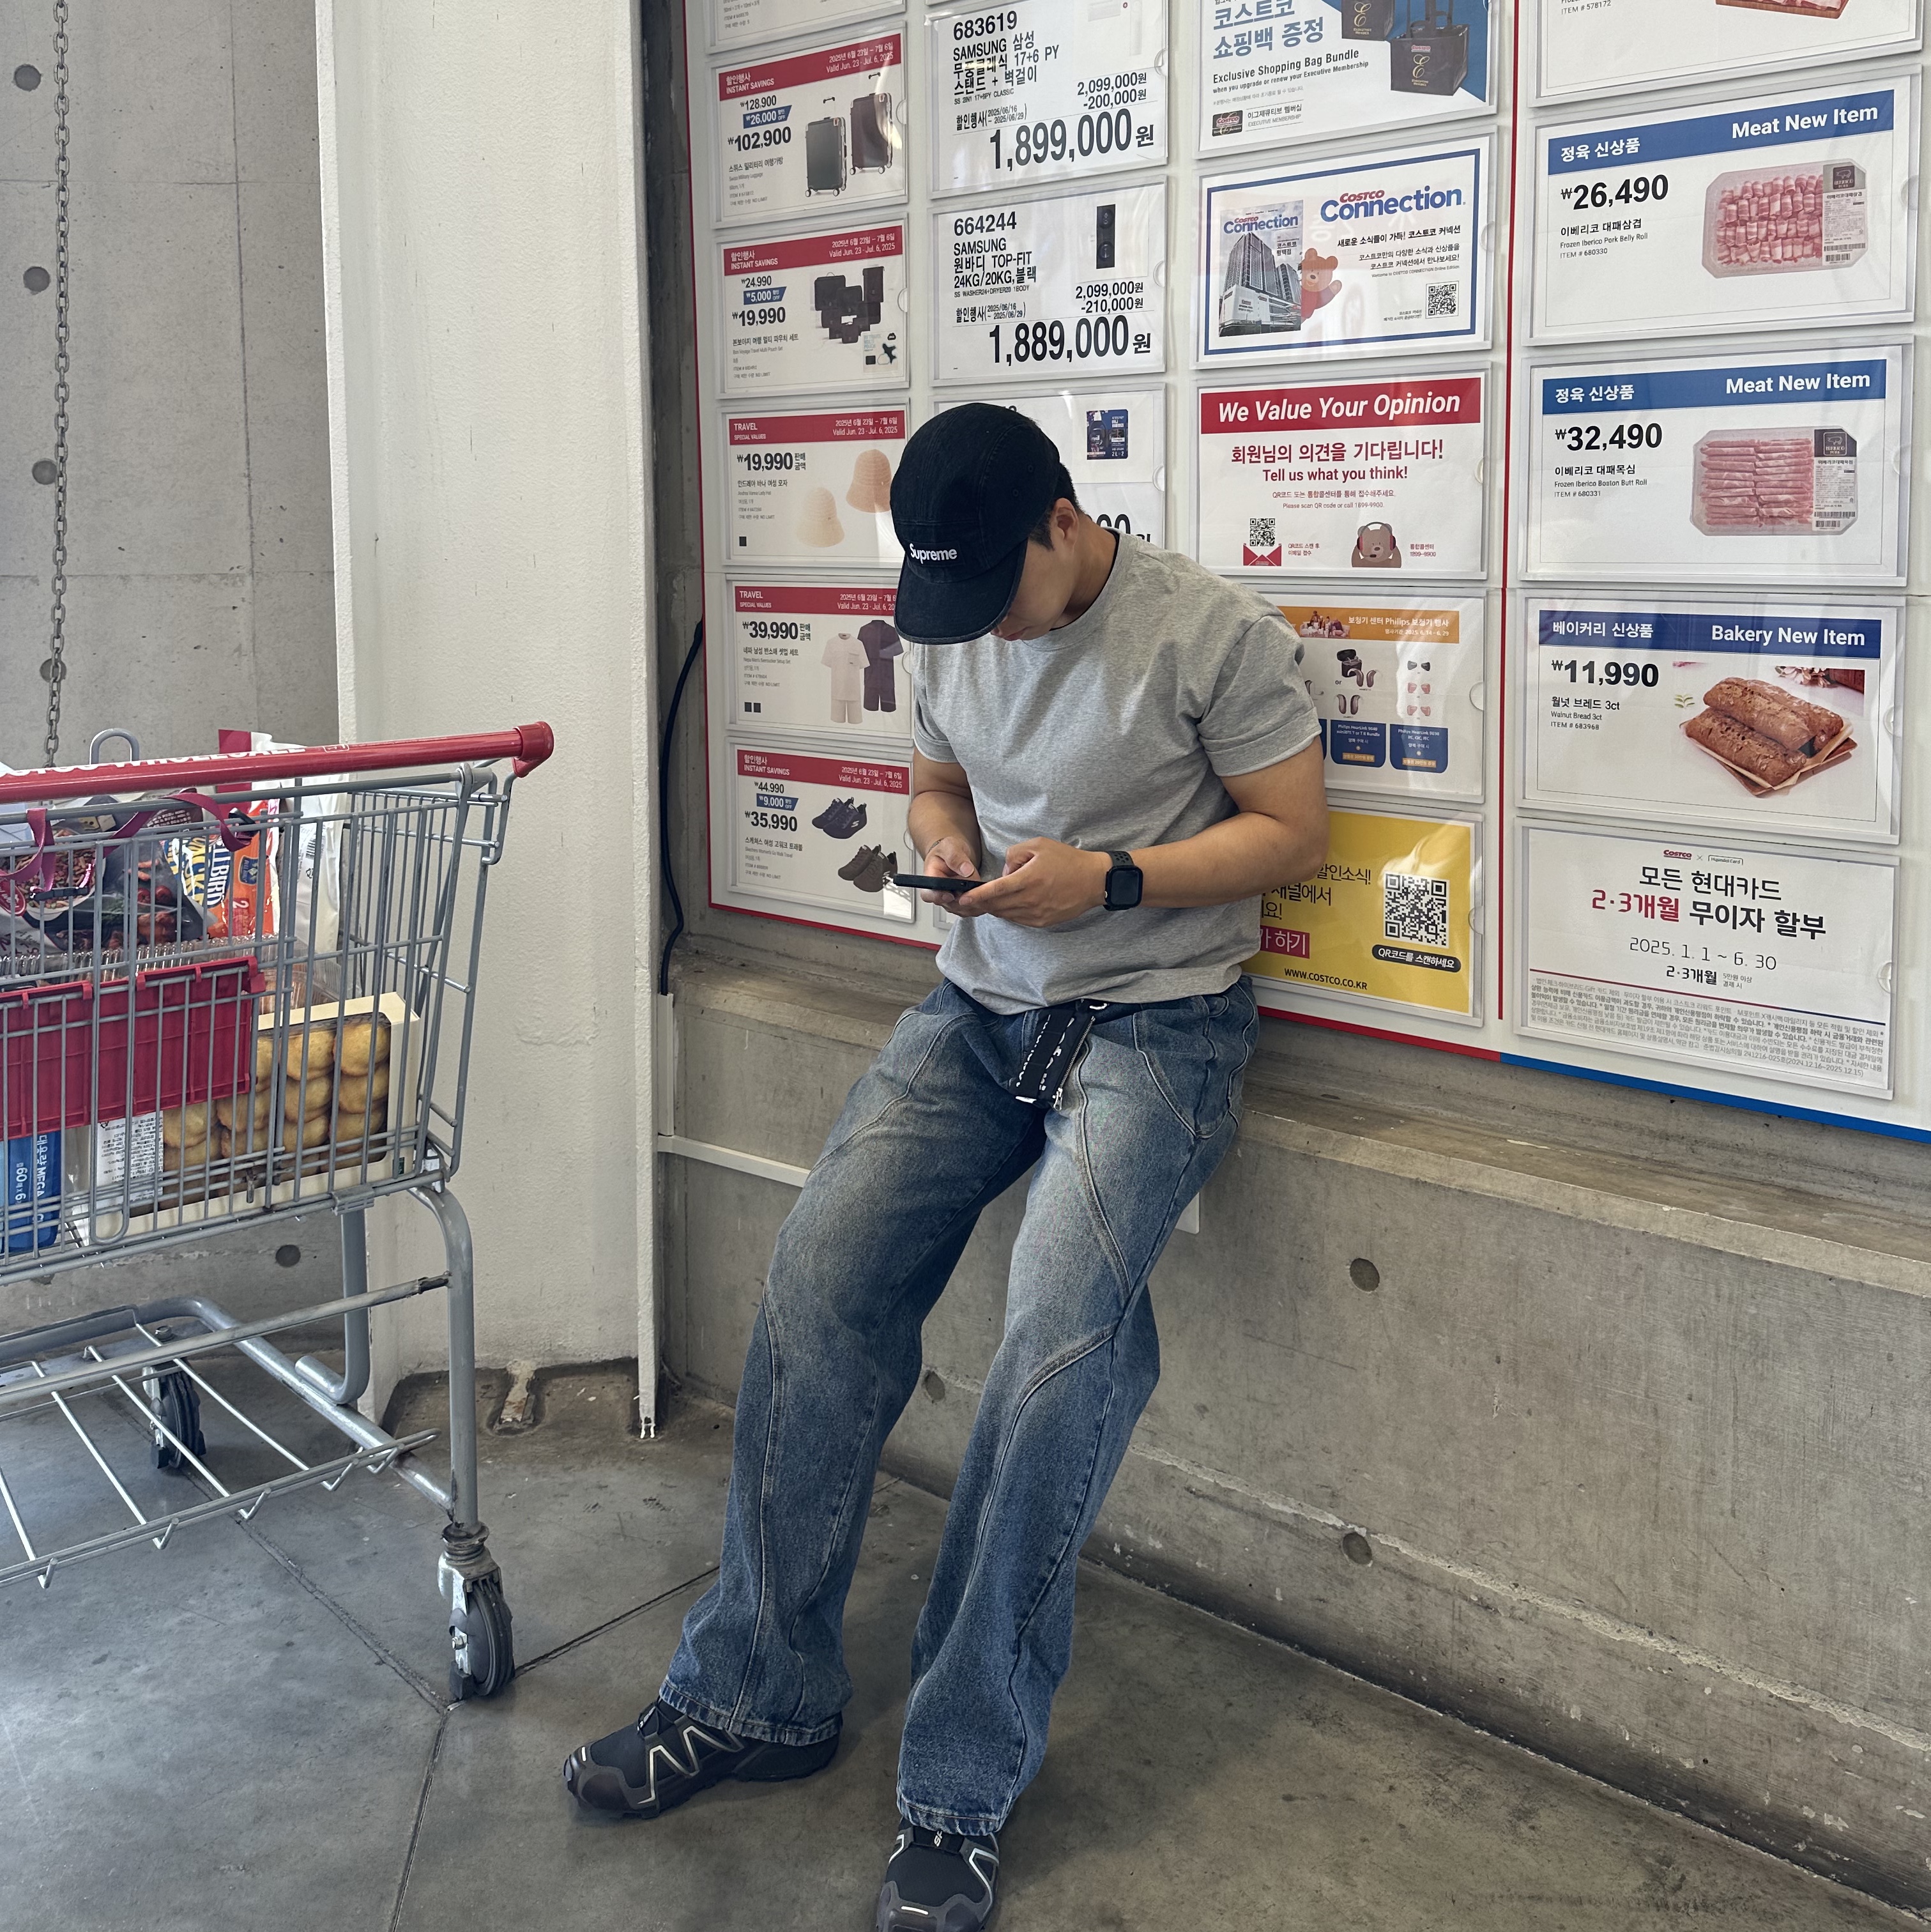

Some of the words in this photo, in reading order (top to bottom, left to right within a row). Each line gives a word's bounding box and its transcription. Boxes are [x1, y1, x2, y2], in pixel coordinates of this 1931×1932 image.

[1214, 0, 1295, 31] 코스트코
[1562, 6, 1578, 15] ITEM
[953, 11, 1018, 40] 683619
[953, 38, 1007, 61] SAMSUNG
[1012, 31, 1034, 51] 삼성
[1214, 26, 1273, 59] 쇼핑백
[1282, 17, 1324, 48] 증정
[1014, 49, 1039, 66] 17+6
[1045, 45, 1059, 61] PY
[1213, 66, 1255, 84] Exclusive
[1258, 60, 1301, 79] Shopping
[1304, 56, 1323, 70] Bag
[1325, 49, 1359, 64] Bundle
[1240, 80, 1262, 91] upgrade
[1289, 73, 1302, 81] your
[1304, 67, 1331, 79] Executive
[1333, 60, 1369, 74] Membership
[726, 82, 749, 95] INSTANT
[750, 78, 774, 89] SAVINGS
[954, 77, 986, 96] 스탠드
[1005, 66, 1037, 86] 벽걸이
[1078, 72, 1147, 96] 2,099,000원
[740, 95, 776, 111] ₩128,900
[1083, 88, 1147, 110] -200,000원
[746, 111, 776, 125] ₩26,000
[1731, 120, 1780, 139] Meat
[1785, 114, 1828, 133] New
[1833, 106, 1878, 125] Item
[728, 127, 791, 152] ₩102,900
[1561, 142, 1590, 163] 정육
[1594, 137, 1640, 158] 신상품
[1339, 190, 1385, 204] COSTCO
[1561, 174, 1669, 210] ₩26,490
[1320, 185, 1462, 222] Connection
[954, 211, 1017, 236] 664244
[1224, 214, 1298, 234] Connection
[1561, 224, 1599, 238] 이베리코
[1602, 218, 1642, 233] 대패삼겹
[1338, 238, 1357, 247] 새로운
[1359, 234, 1387, 245] 소식들이
[1389, 231, 1405, 241] 가득!
[1408, 229, 1436, 238] 코스트코
[1439, 225, 1461, 235] 커넥션
[1582, 238, 1602, 247] Iberico
[1605, 236, 1618, 245] Pork
[1620, 234, 1635, 244] Belly
[1637, 233, 1648, 241] Roll
[954, 238, 1007, 256] SAMSUNG
[1584, 247, 1608, 257] 680330
[954, 254, 985, 274] 원바디
[991, 251, 1032, 269] TOP-FIT
[954, 266, 1036, 289] 24KG/20KG,블랙
[746, 291, 771, 302] ₩5,000
[1076, 281, 1143, 299] 2,099,000원
[732, 307, 786, 326] ₩19,990
[1081, 298, 1143, 314] -210,000원
[1555, 387, 1585, 403] 정육
[1589, 385, 1635, 401] 신상품
[1726, 378, 1773, 394] Meat
[1778, 375, 1820, 392] New
[1826, 373, 1870, 390] Item
[1219, 402, 1249, 422] We
[1255, 399, 1311, 420] Value
[1319, 397, 1368, 418] Your
[1373, 392, 1460, 420] Opinion
[734, 423, 758, 431] TRAVEL
[1555, 423, 1663, 452] ₩32,490
[737, 452, 793, 471] ₩19,990
[1232, 445, 1292, 464] 회원님의
[1299, 442, 1347, 463] 의견을
[1354, 440, 1443, 461] 기다립니다!
[1263, 468, 1285, 482] Tell
[1289, 470, 1304, 480] us
[1307, 468, 1338, 480] what
[1341, 468, 1365, 483] you
[1370, 466, 1408, 479] think!
[1555, 466, 1594, 476] 이베리코
[1597, 464, 1636, 475] 대패목심
[910, 543, 958, 564] Supreme
[740, 591, 763, 599] TRAVEL
[742, 621, 798, 640] ₩39,990
[1385, 618, 1410, 626] Philips
[1411, 618, 1432, 627] 보청기
[1553, 621, 1606, 636] 베이커리
[1612, 622, 1654, 639] 신상품
[1711, 625, 1773, 647] Bakery
[1778, 628, 1818, 645] New
[1823, 629, 1865, 646] Item
[1551, 659, 1659, 687] ₩11,990
[1551, 696, 1570, 709] 월넛
[1573, 697, 1601, 710] 브레드
[1605, 700, 1620, 711] 3ct
[754, 781, 784, 794] ₩44,990
[759, 795, 784, 808] ₩9,000
[745, 811, 797, 832] ₩35,990
[1663, 849, 1692, 857] COSTCO
[1640, 866, 1683, 891] 모든
[1691, 871, 1782, 901] 현대카드
[1592, 889, 1679, 923] 2·3개월
[1689, 900, 1766, 933] 무이자
[1774, 910, 1826, 940] 할부
[1275, 931, 1306, 955] 하기
[1378, 948, 1414, 963] QR코드를
[1416, 954, 1455, 969] 스캔하세요
[1630, 937, 1675, 956] 2025.
[1681, 945, 1694, 958] 1.
[1701, 947, 1709, 962] 1
[1734, 952, 1748, 967] 6.
[1755, 956, 1776, 971] 30
[1284, 967, 1368, 990] WWW.COSTCO.CO.KR
